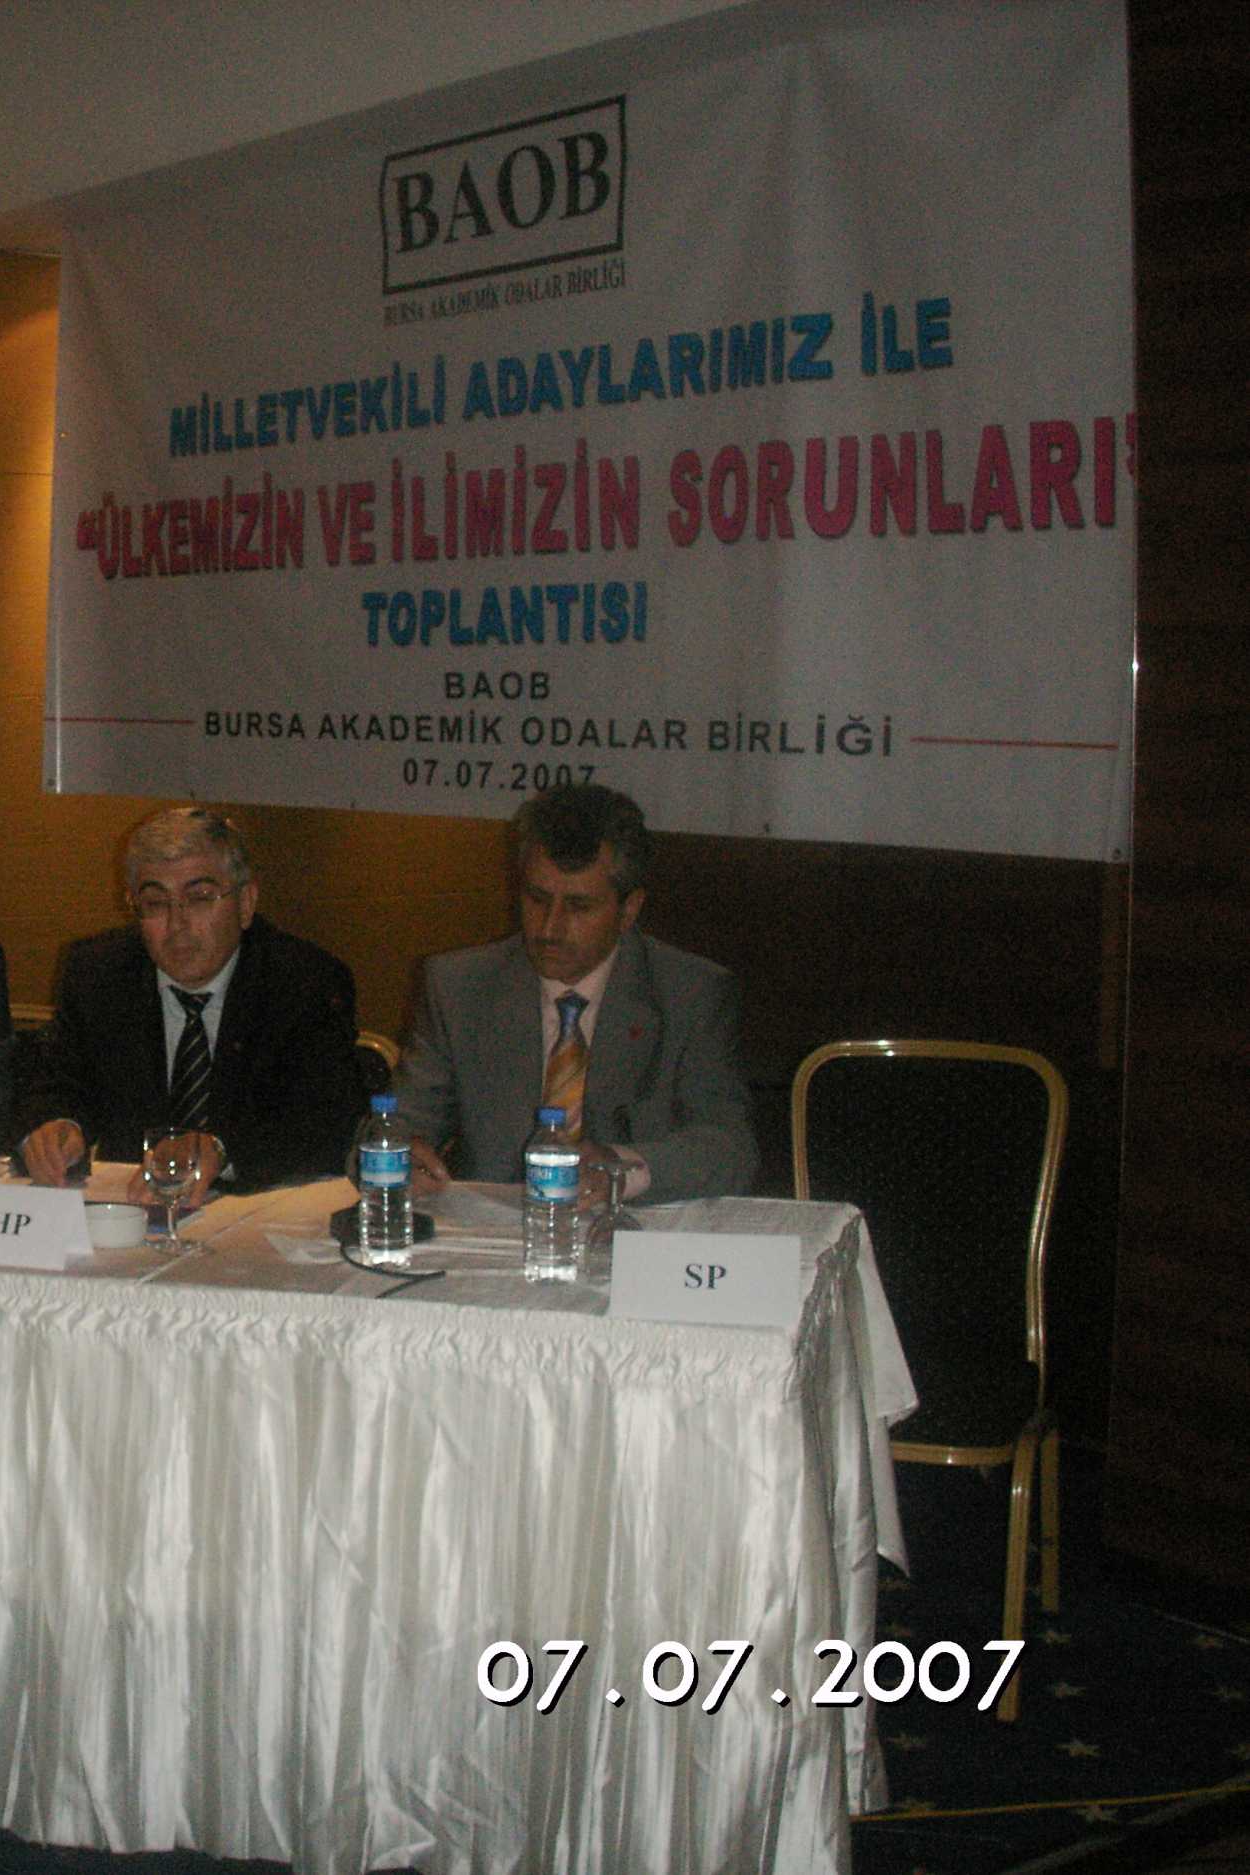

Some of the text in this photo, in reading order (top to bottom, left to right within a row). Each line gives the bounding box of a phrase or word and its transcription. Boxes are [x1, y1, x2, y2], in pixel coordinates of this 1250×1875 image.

[393, 131, 610, 253] BAOB
[169, 290, 954, 457] MİLLETVEKİLİ ADAYLARIMIZ İLE
[317, 480, 377, 567] VE
[391, 437, 642, 564] İLİMİZİN
[361, 581, 648, 648] TOPLANTISI
[445, 672, 550, 701] BAOB
[204, 709, 893, 757] BURSA AKADEMİK ODALAR BİRLİĞİ
[684, 1263, 727, 1290] SP
